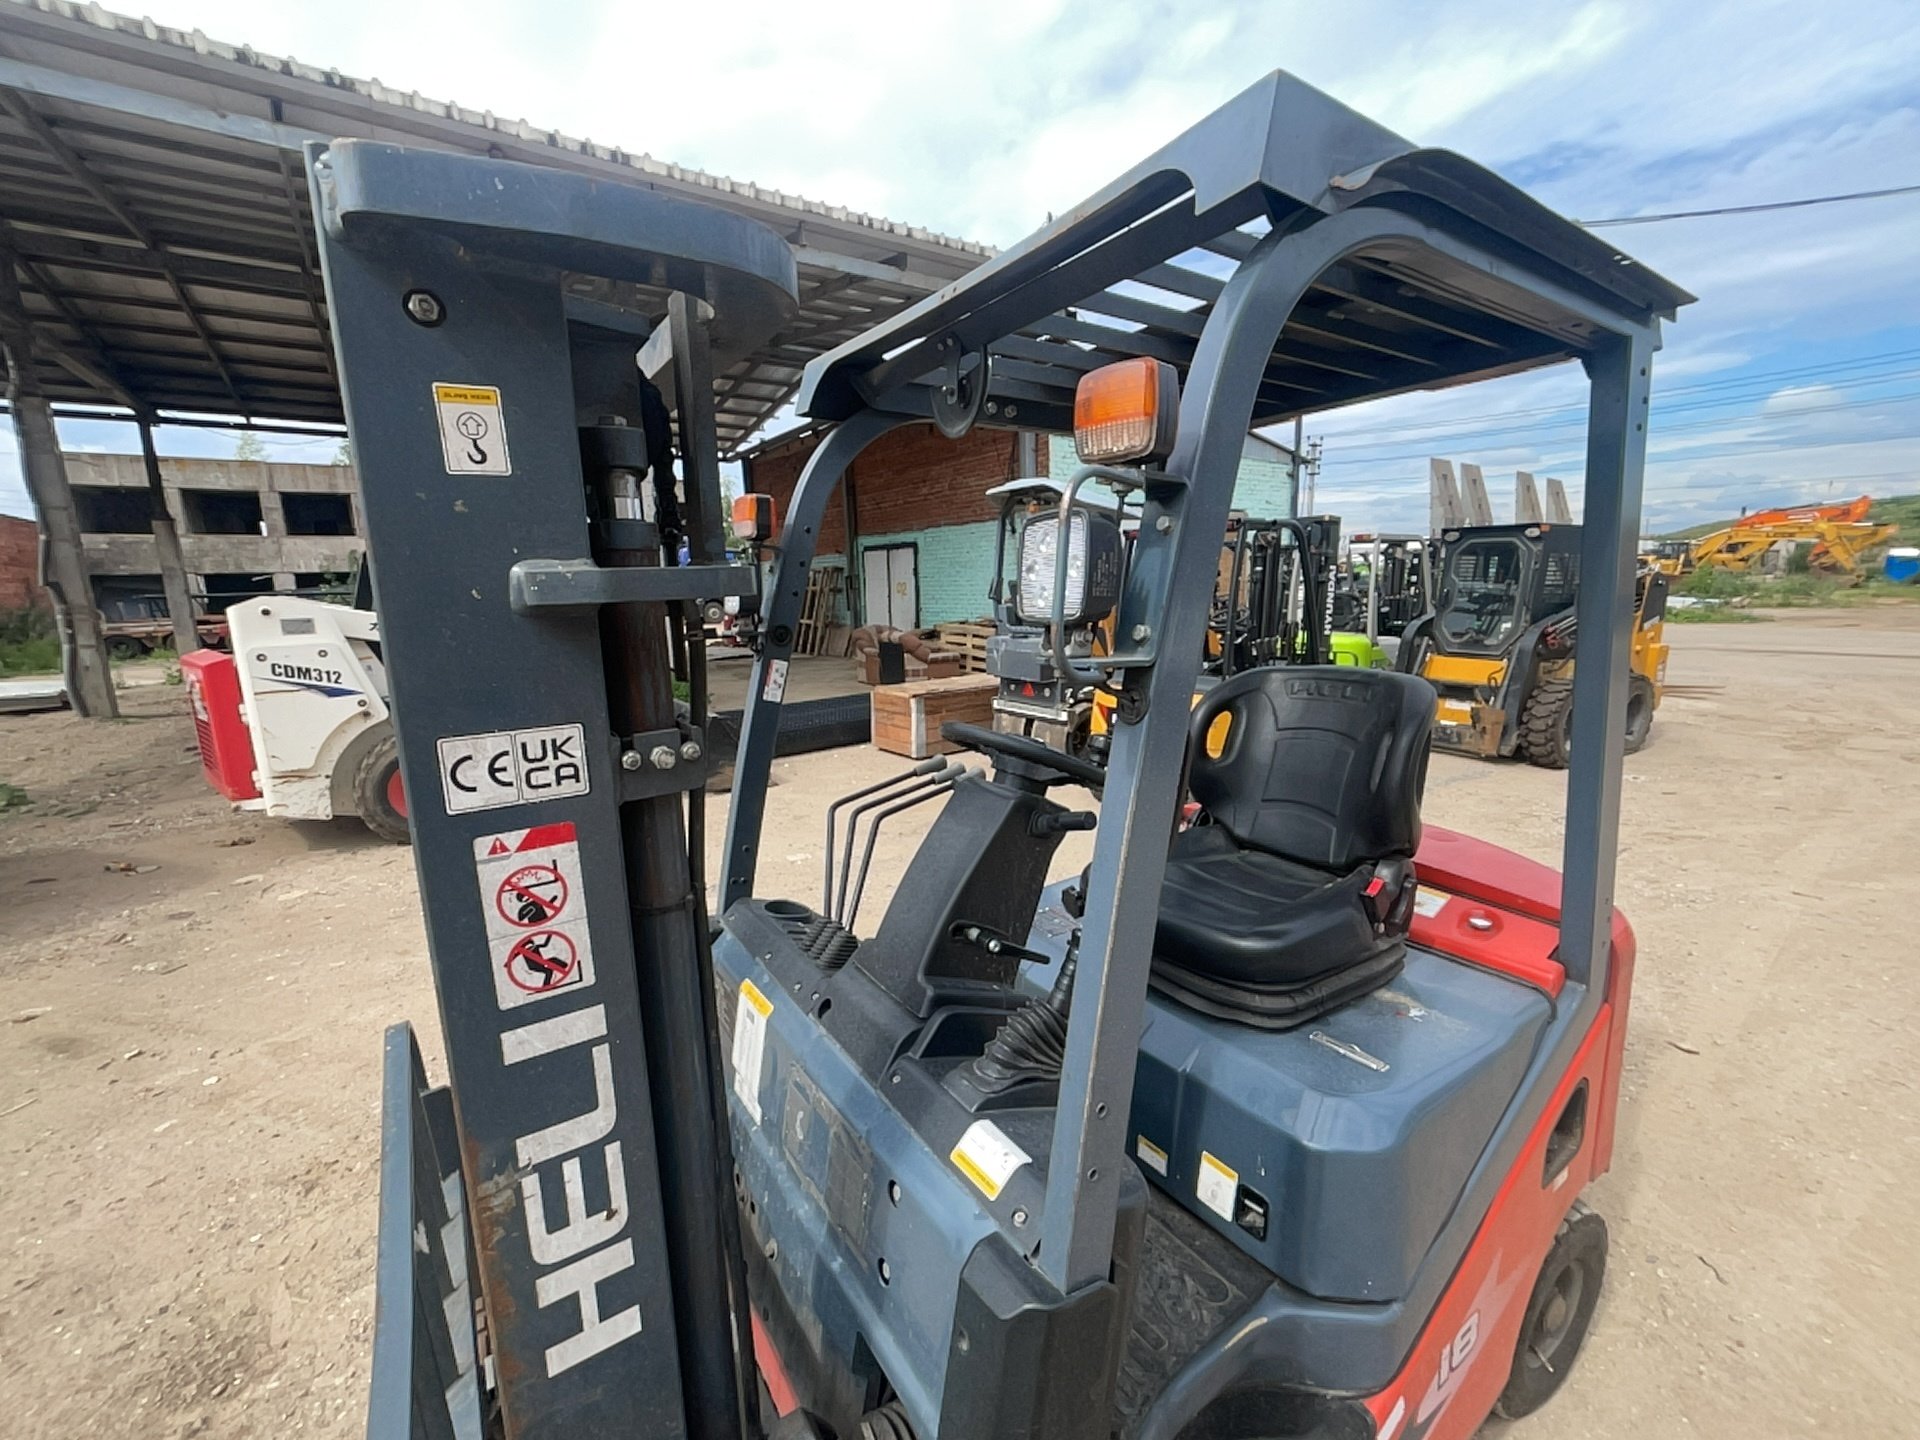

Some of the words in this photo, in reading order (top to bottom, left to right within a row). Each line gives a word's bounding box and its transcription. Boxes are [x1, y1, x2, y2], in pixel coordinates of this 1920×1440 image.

[1324, 565, 1337, 635] HYUNDAI
[271, 663, 342, 684] CDM312
[521, 736, 576, 763] UK
[450, 750, 514, 792] CE
[525, 763, 581, 790] CA
[500, 1003, 642, 1378] HELI
